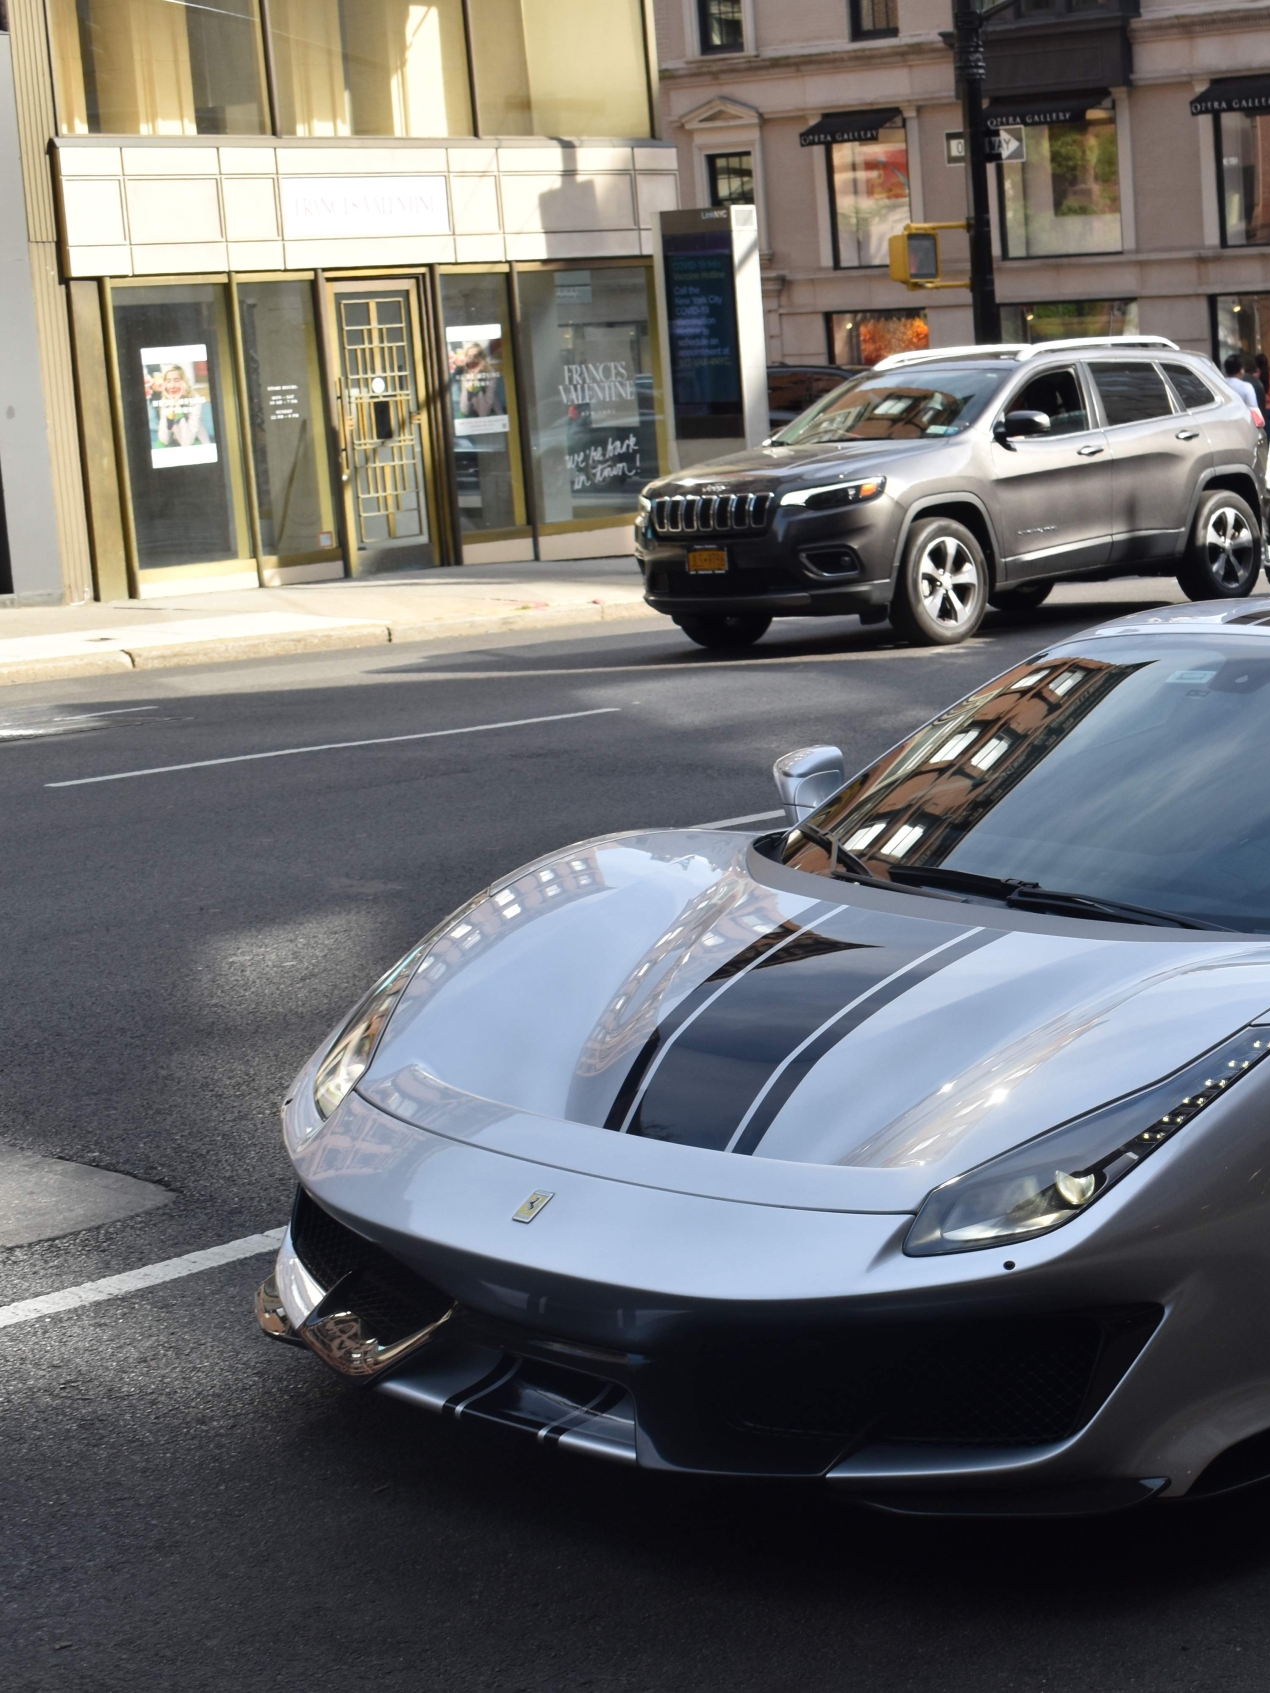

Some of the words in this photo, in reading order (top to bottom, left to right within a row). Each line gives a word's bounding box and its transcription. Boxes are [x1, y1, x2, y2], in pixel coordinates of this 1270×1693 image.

[987, 114, 1021, 127] OPERA
[1026, 111, 1071, 123] GALLERY
[1191, 101, 1227, 114] OPERA
[801, 133, 832, 145] OPERA
[836, 129, 878, 141] GALLERY
[563, 362, 628, 385] FRANCES
[558, 380, 636, 404] VALENTINE
[565, 446, 603, 469] we're
[605, 433, 639, 459] back
[573, 473, 591, 490] in
[591, 453, 641, 483] town!
